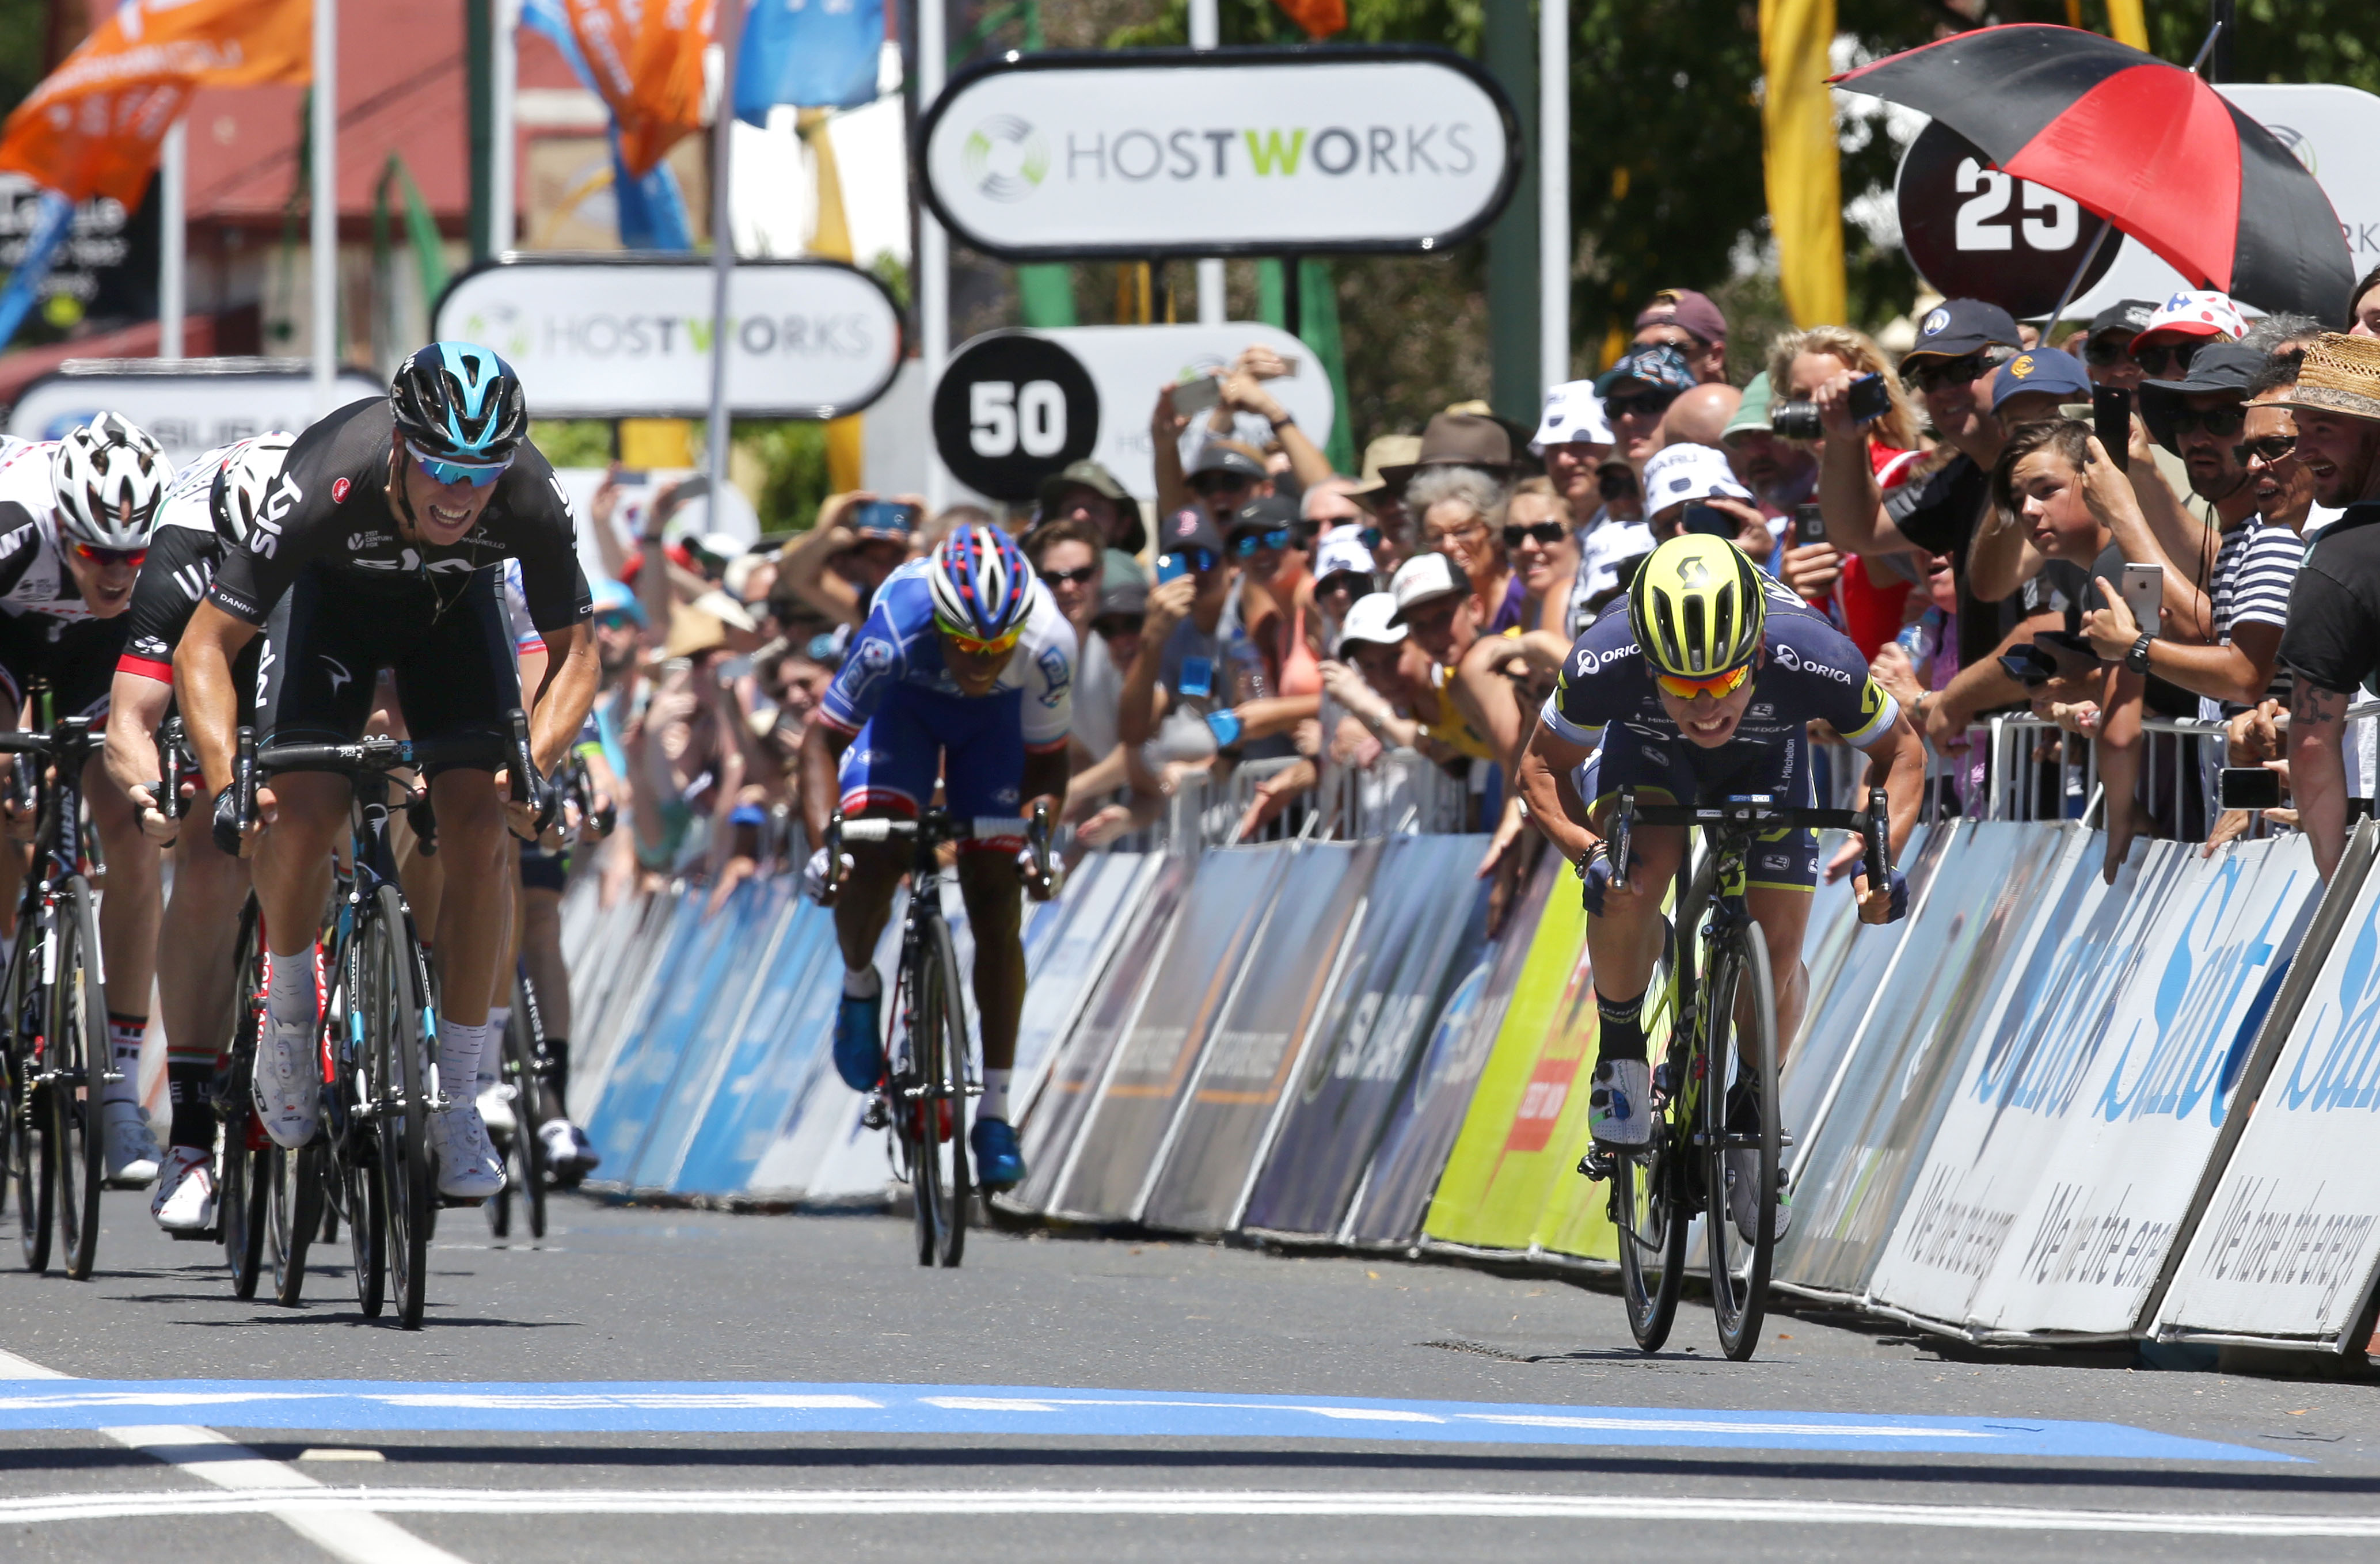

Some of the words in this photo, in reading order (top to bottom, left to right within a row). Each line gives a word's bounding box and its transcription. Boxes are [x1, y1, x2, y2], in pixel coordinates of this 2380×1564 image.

[1066, 121, 1477, 182] HOSTWORKS
[1955, 156, 2079, 251] 25
[968, 380, 1068, 457] 50
[219, 593, 258, 615] DANNY
[1600, 643, 1641, 663] ORIC
[1803, 660, 1851, 685] ORICA
[2197, 1174, 2252, 1280] We
